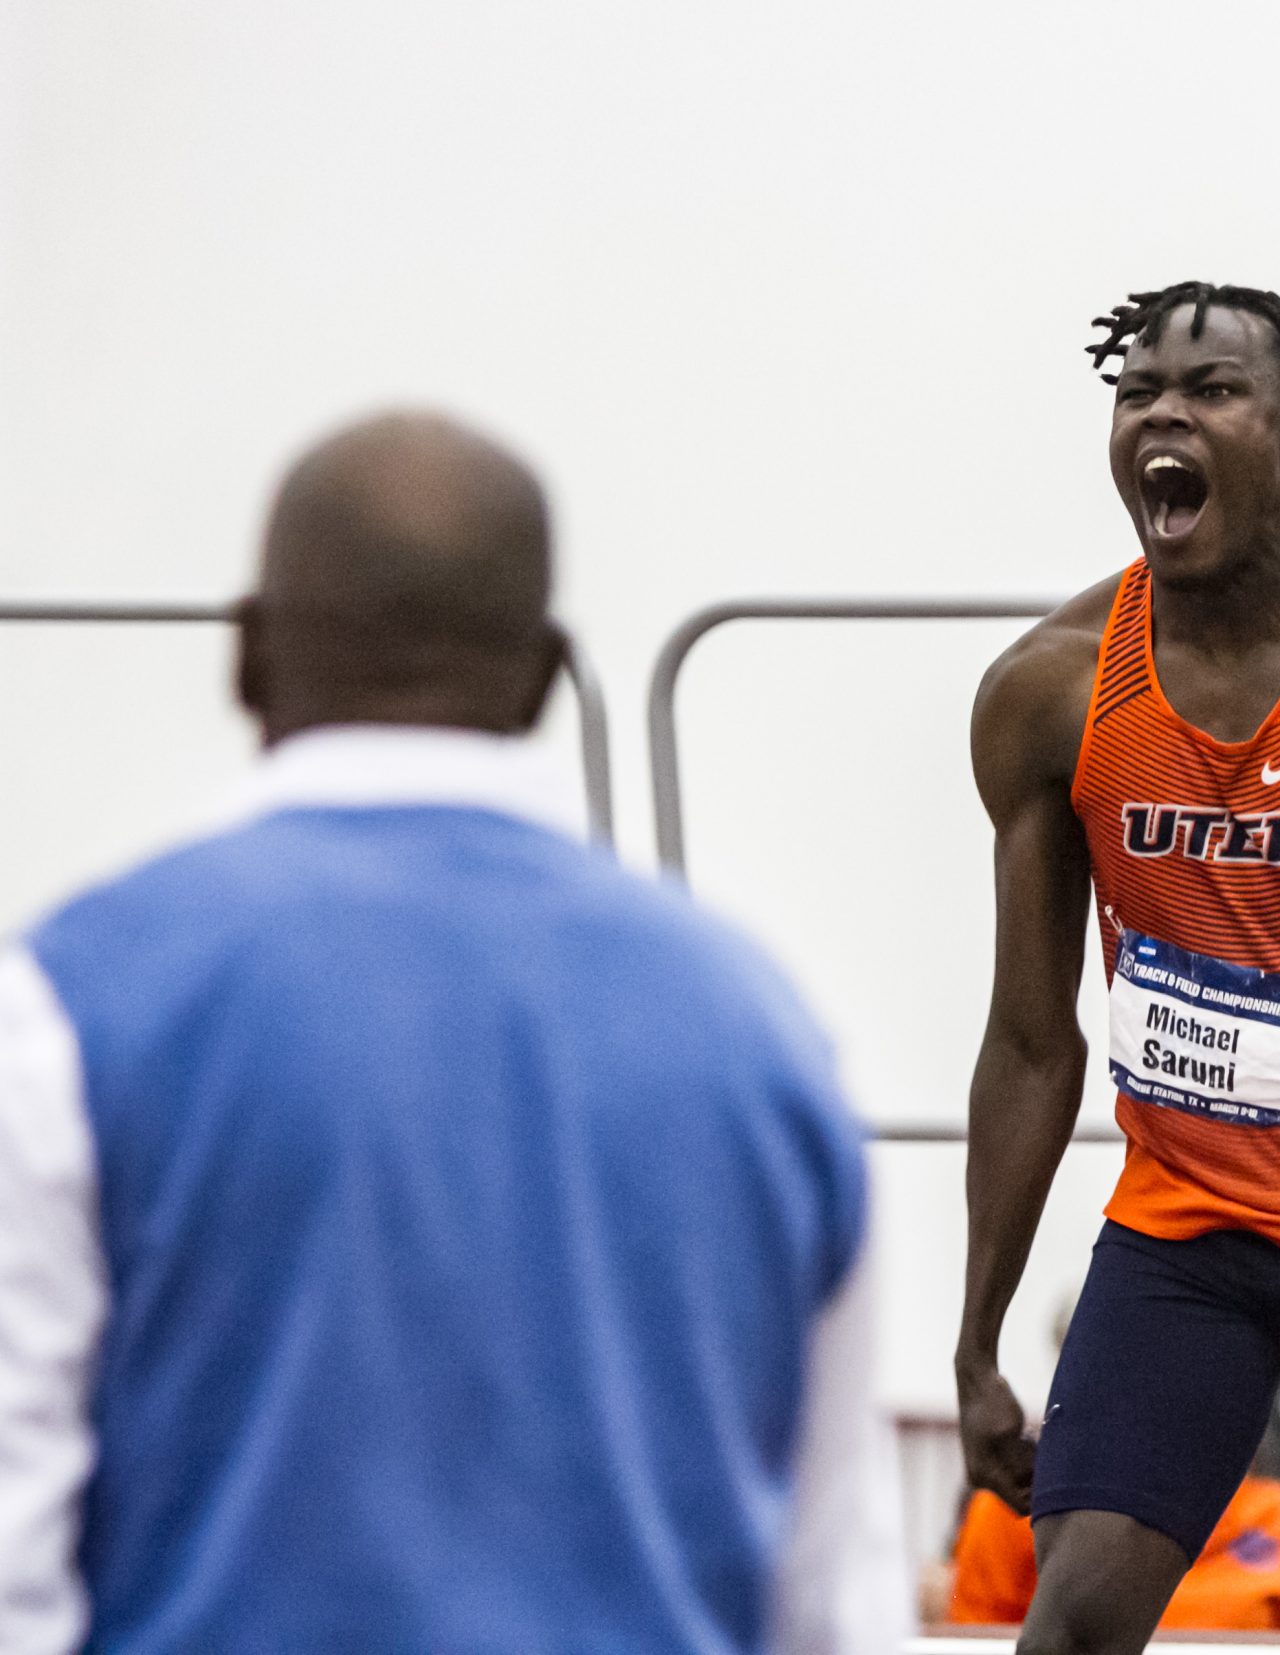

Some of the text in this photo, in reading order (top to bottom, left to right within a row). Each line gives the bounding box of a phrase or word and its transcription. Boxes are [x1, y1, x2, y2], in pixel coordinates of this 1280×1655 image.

[1134, 962, 1168, 984] TRACK
[1175, 976, 1201, 998] FIELD
[1146, 1003, 1240, 1054] Michael
[1142, 1039, 1236, 1092] Saruni
[1188, 1096, 1199, 1106] TX
